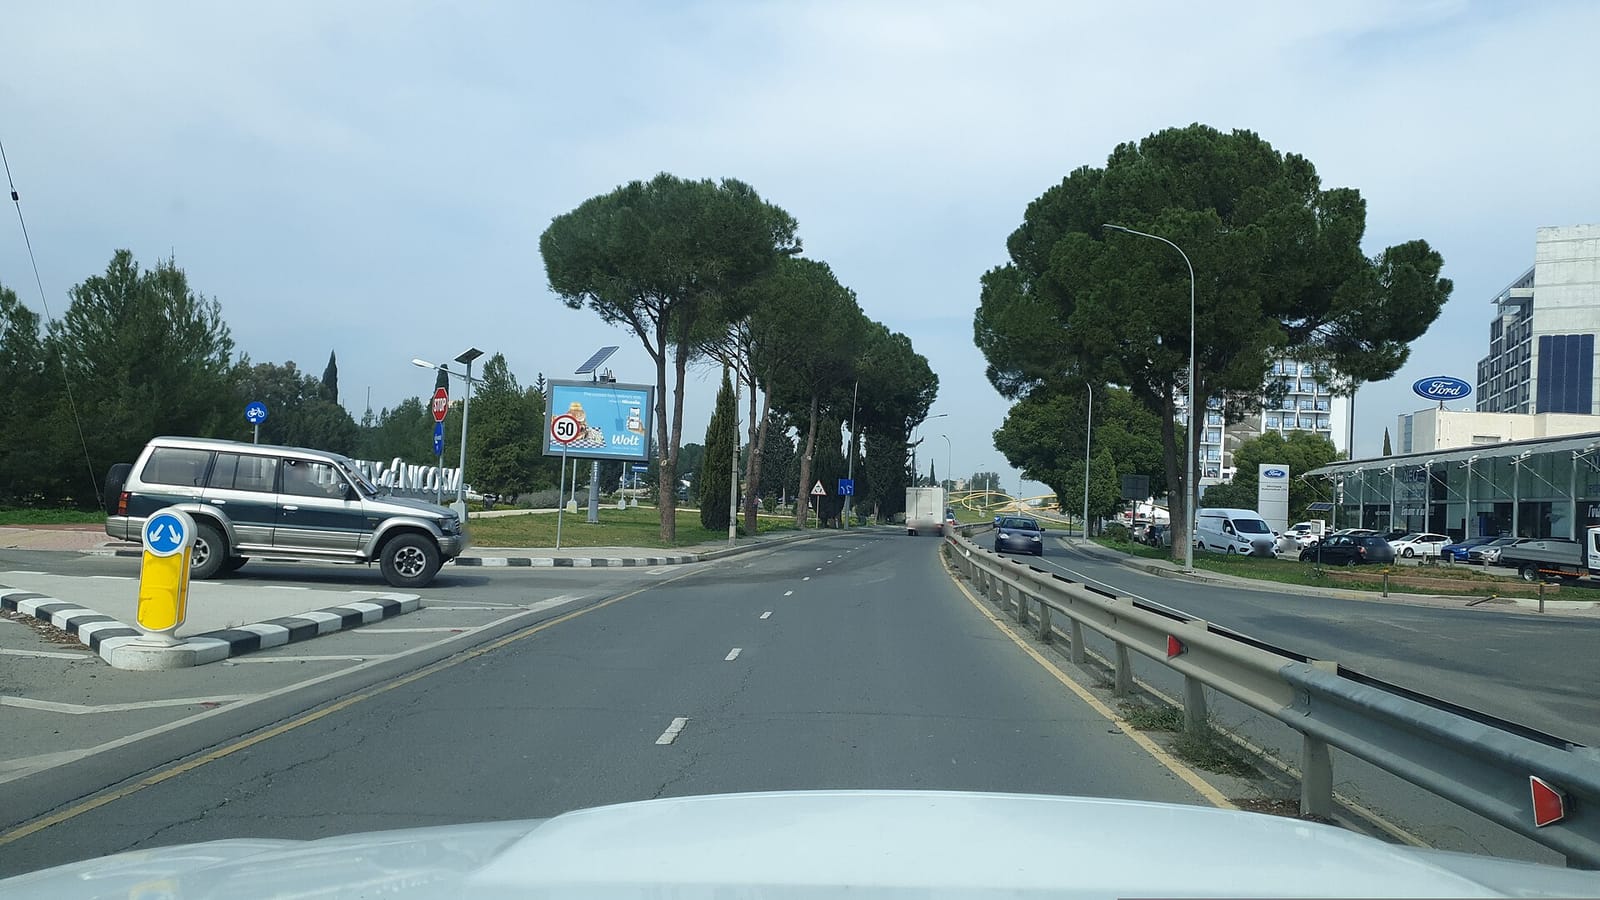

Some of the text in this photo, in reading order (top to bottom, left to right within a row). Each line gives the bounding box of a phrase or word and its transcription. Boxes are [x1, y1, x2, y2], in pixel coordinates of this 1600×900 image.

[1428, 381, 1461, 396] Ford
[433, 397, 446, 412] STOP
[557, 421, 574, 437] 50
[612, 434, 640, 446] Wolt
